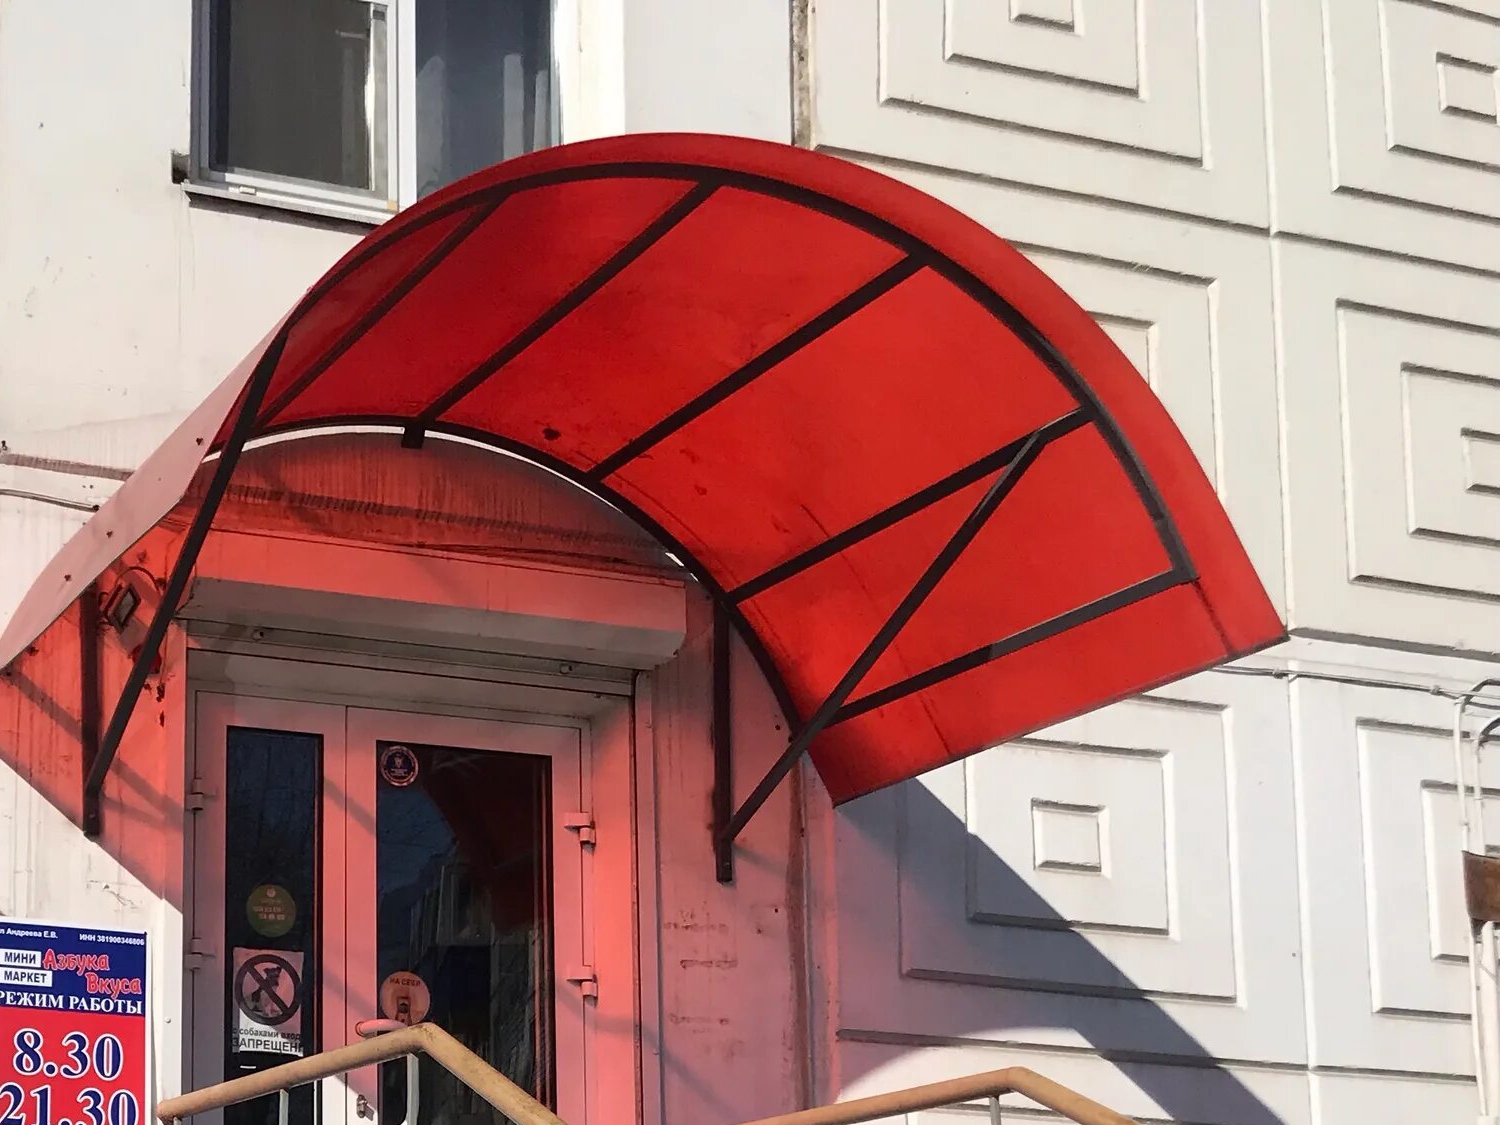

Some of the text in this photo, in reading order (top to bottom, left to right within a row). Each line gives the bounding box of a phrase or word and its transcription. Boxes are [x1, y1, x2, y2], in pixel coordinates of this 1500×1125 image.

[6, 928, 42, 938] Андреева
[79, 933, 96, 942] ИНН
[4, 951, 37, 965] МИНИ
[42, 948, 111, 976] Азбука
[4, 970, 48, 984] МАРКЕТ
[85, 972, 143, 1000] Вкуса
[68, 995, 143, 1015] РАБОТЫ
[239, 1027, 279, 1039] собаками
[12, 1028, 124, 1081] 8.30
